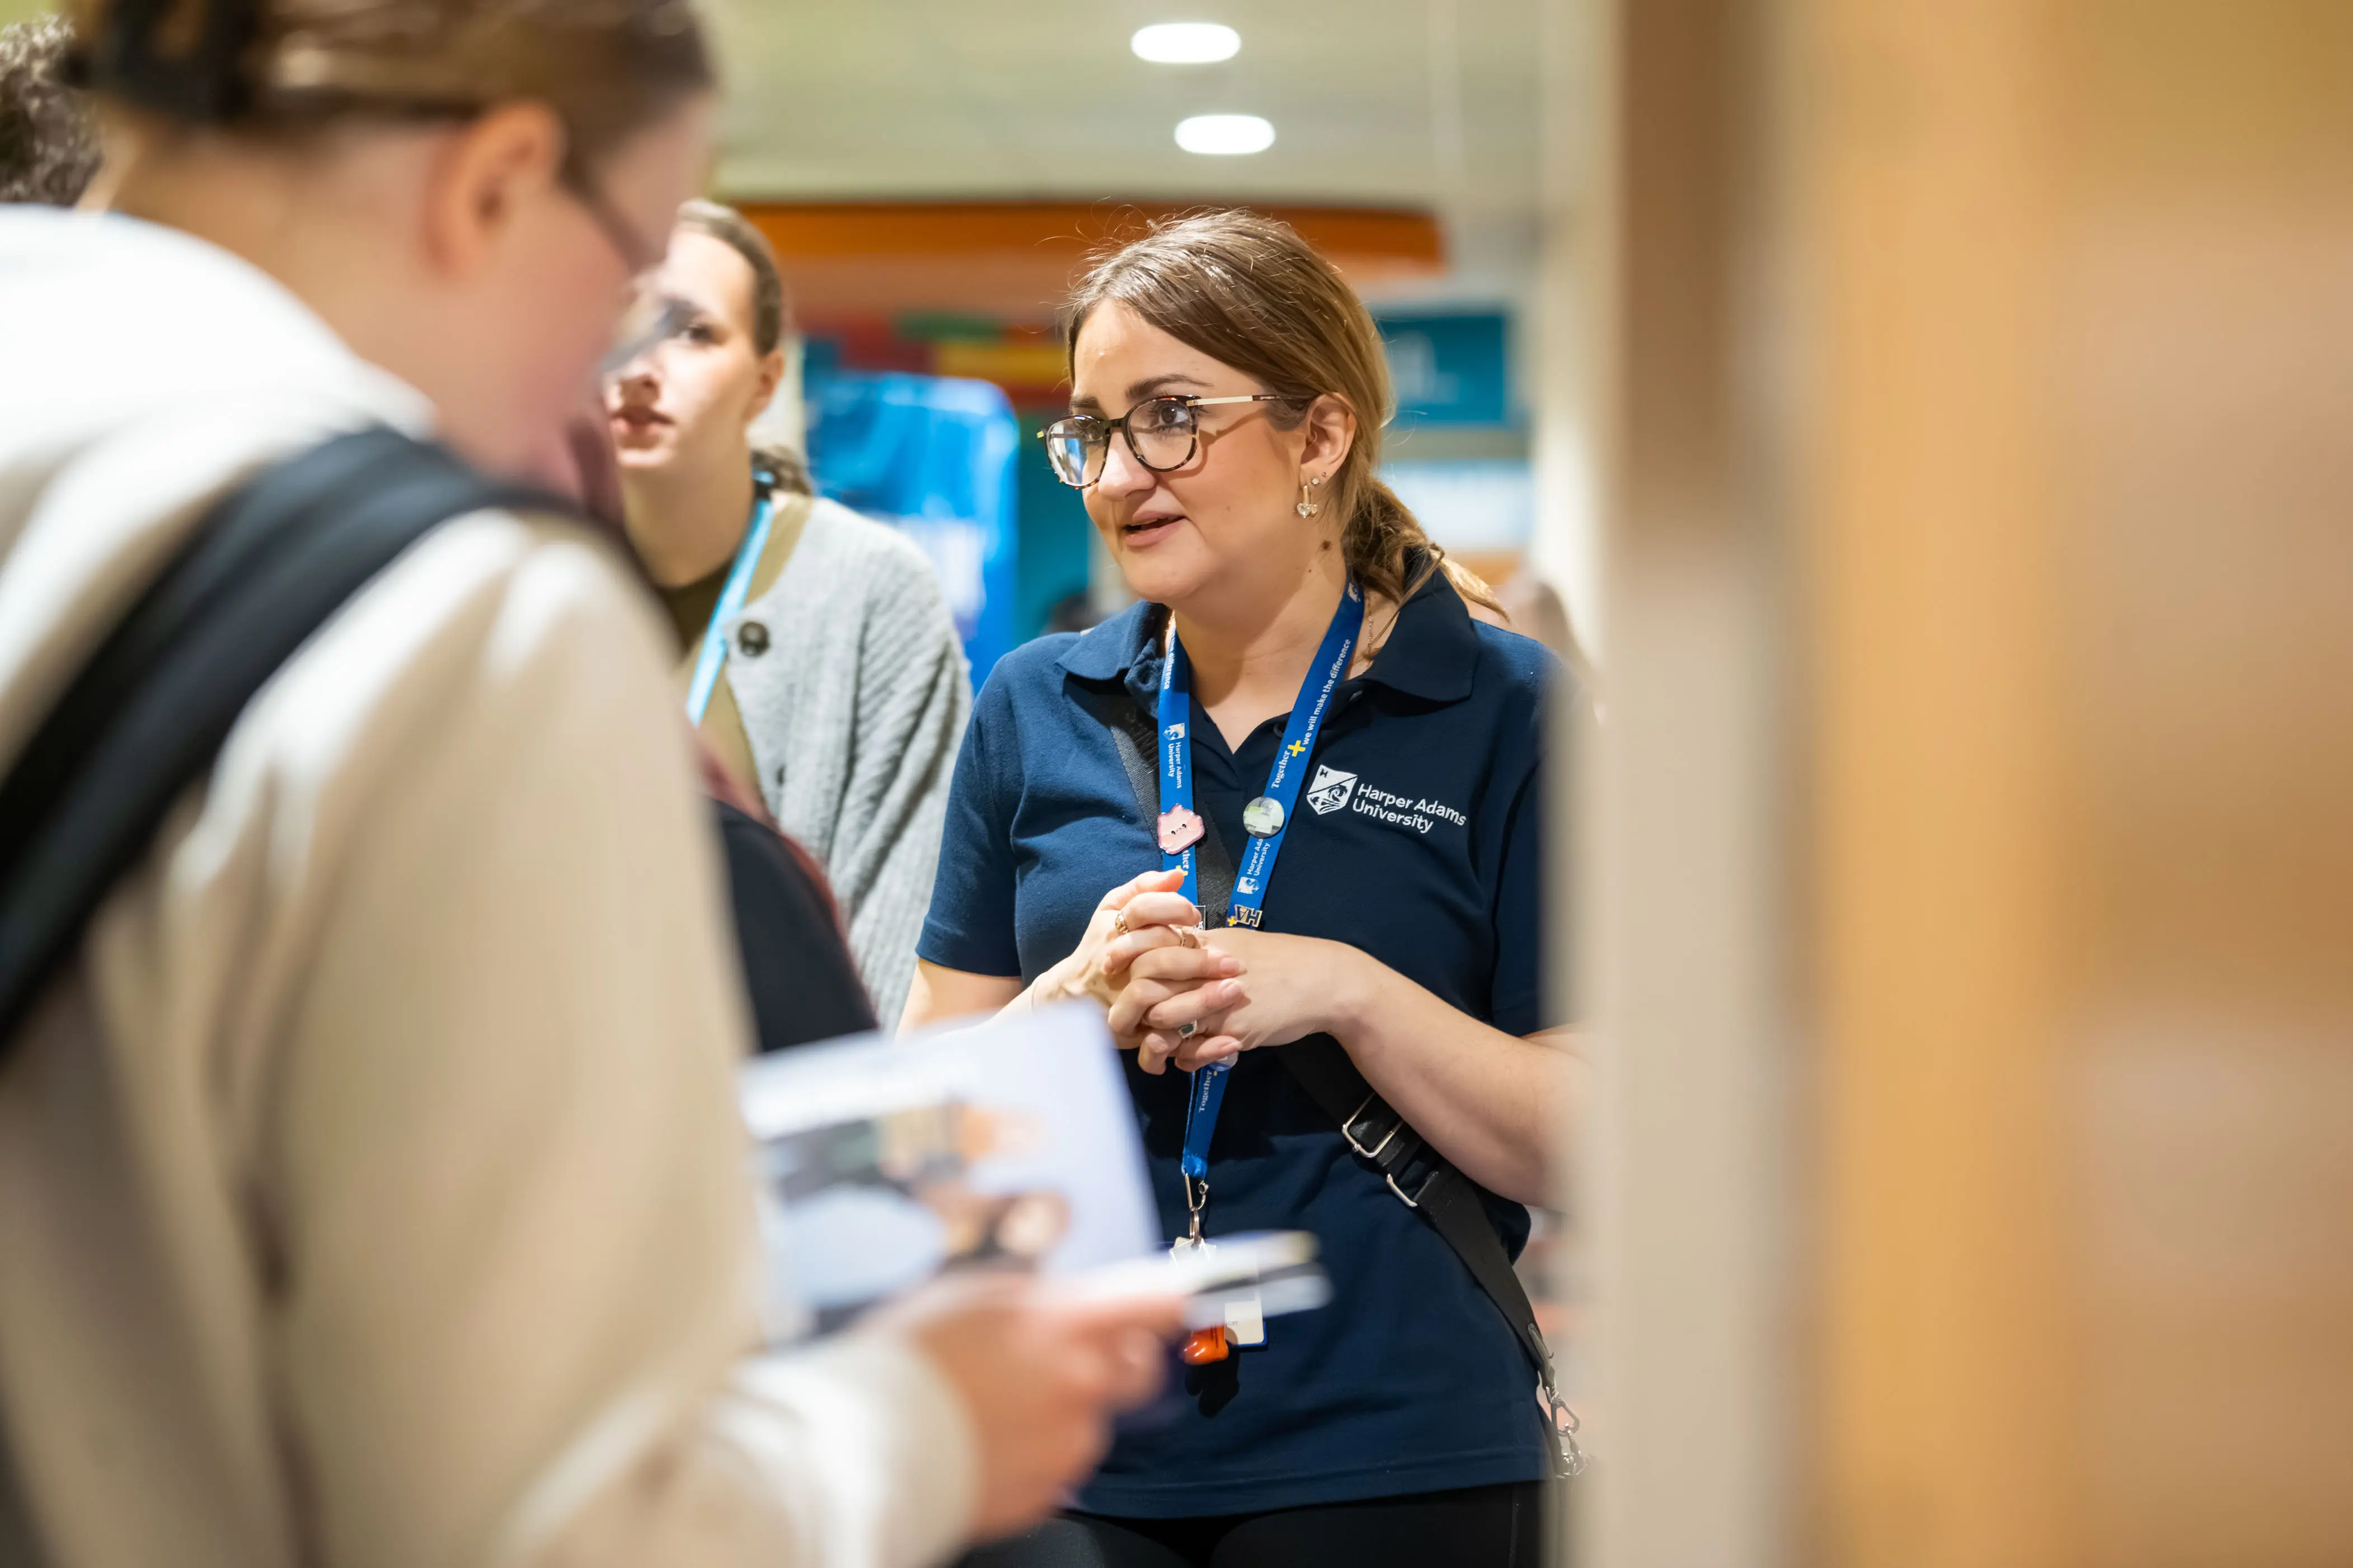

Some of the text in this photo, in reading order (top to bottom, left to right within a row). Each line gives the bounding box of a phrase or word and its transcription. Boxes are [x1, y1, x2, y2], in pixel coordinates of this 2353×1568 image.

[1163, 652, 1175, 690] difference
[1271, 639, 1351, 789] Together we will make the difference
[1167, 743, 1176, 777] University
[1352, 798, 1434, 834] University
[1357, 783, 1467, 826] Harper Adams
[1246, 838, 1264, 875] Harper Ada
[1253, 842, 1271, 877] University
[1199, 1070, 1212, 1113] Together
